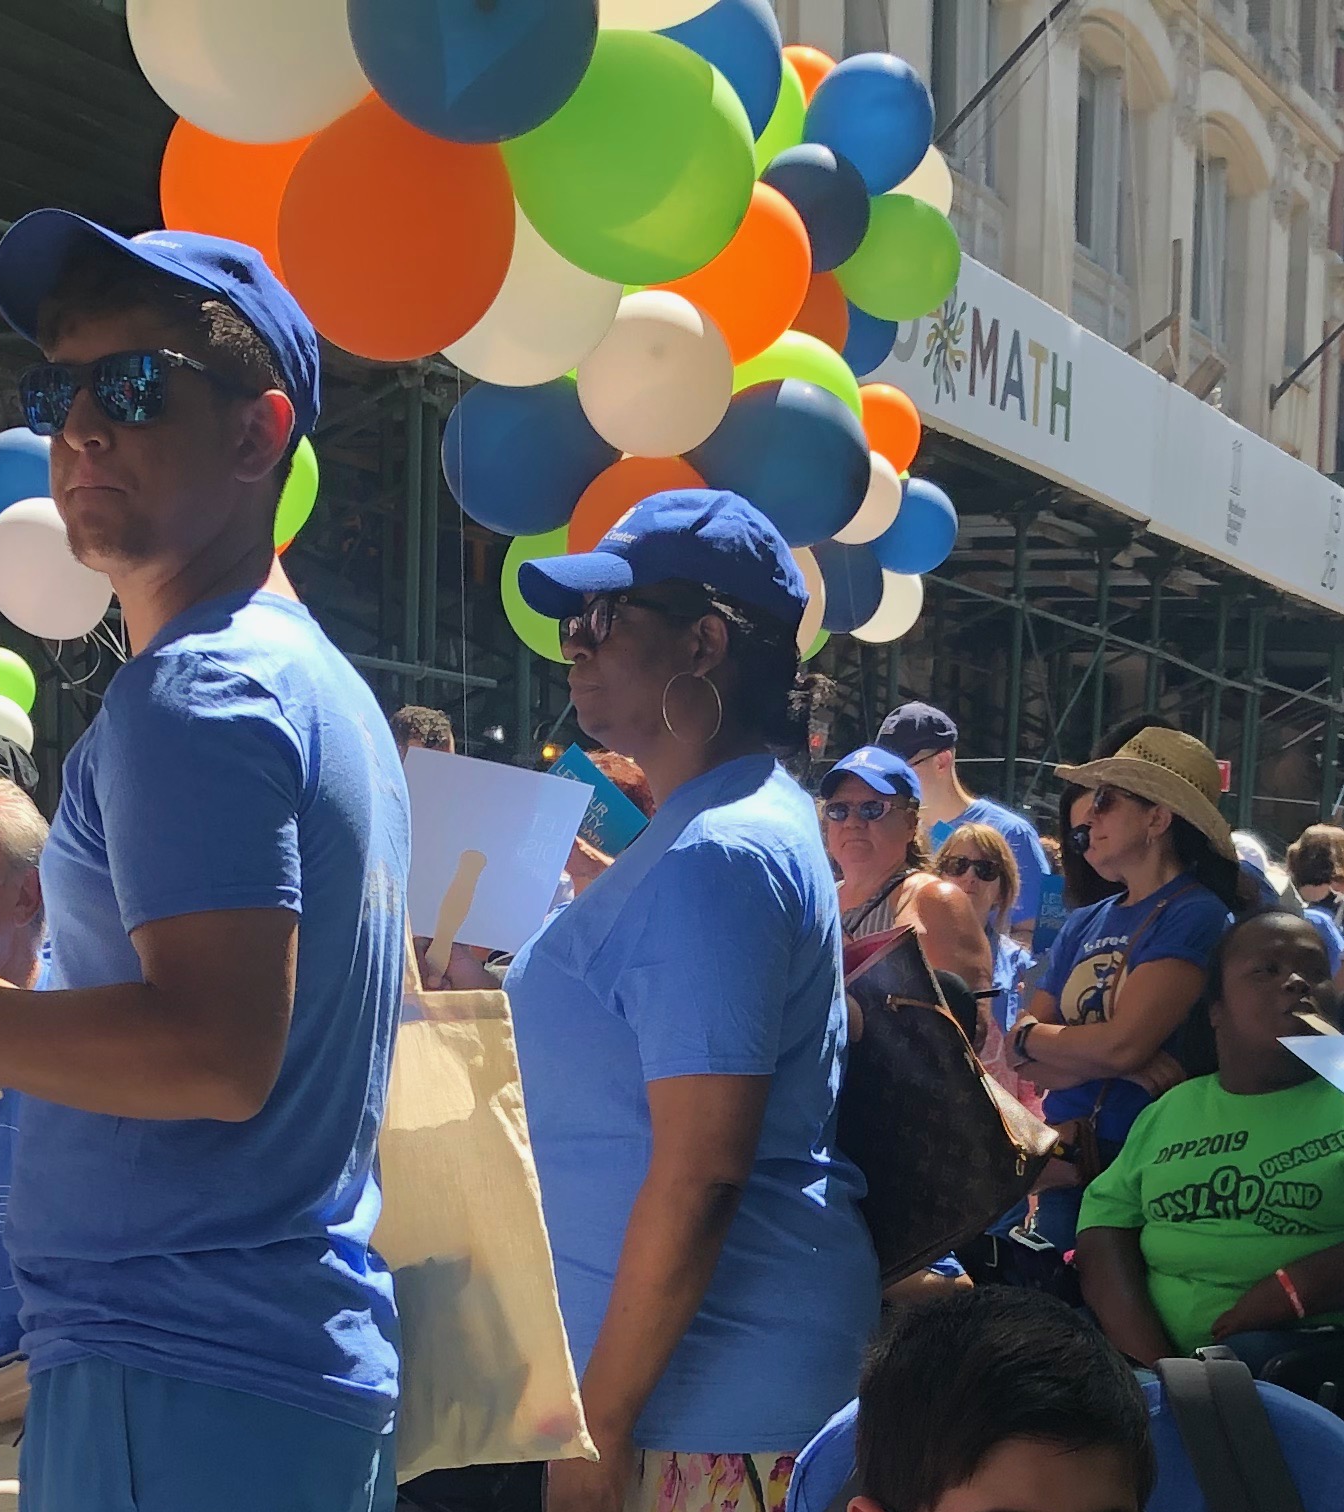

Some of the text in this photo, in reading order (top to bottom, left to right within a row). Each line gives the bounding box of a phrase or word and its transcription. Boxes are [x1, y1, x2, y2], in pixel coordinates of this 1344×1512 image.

[968, 306, 1073, 443] MATH
[1152, 1131, 1250, 1165] DPP2019
[1265, 1181, 1323, 1210] AND
